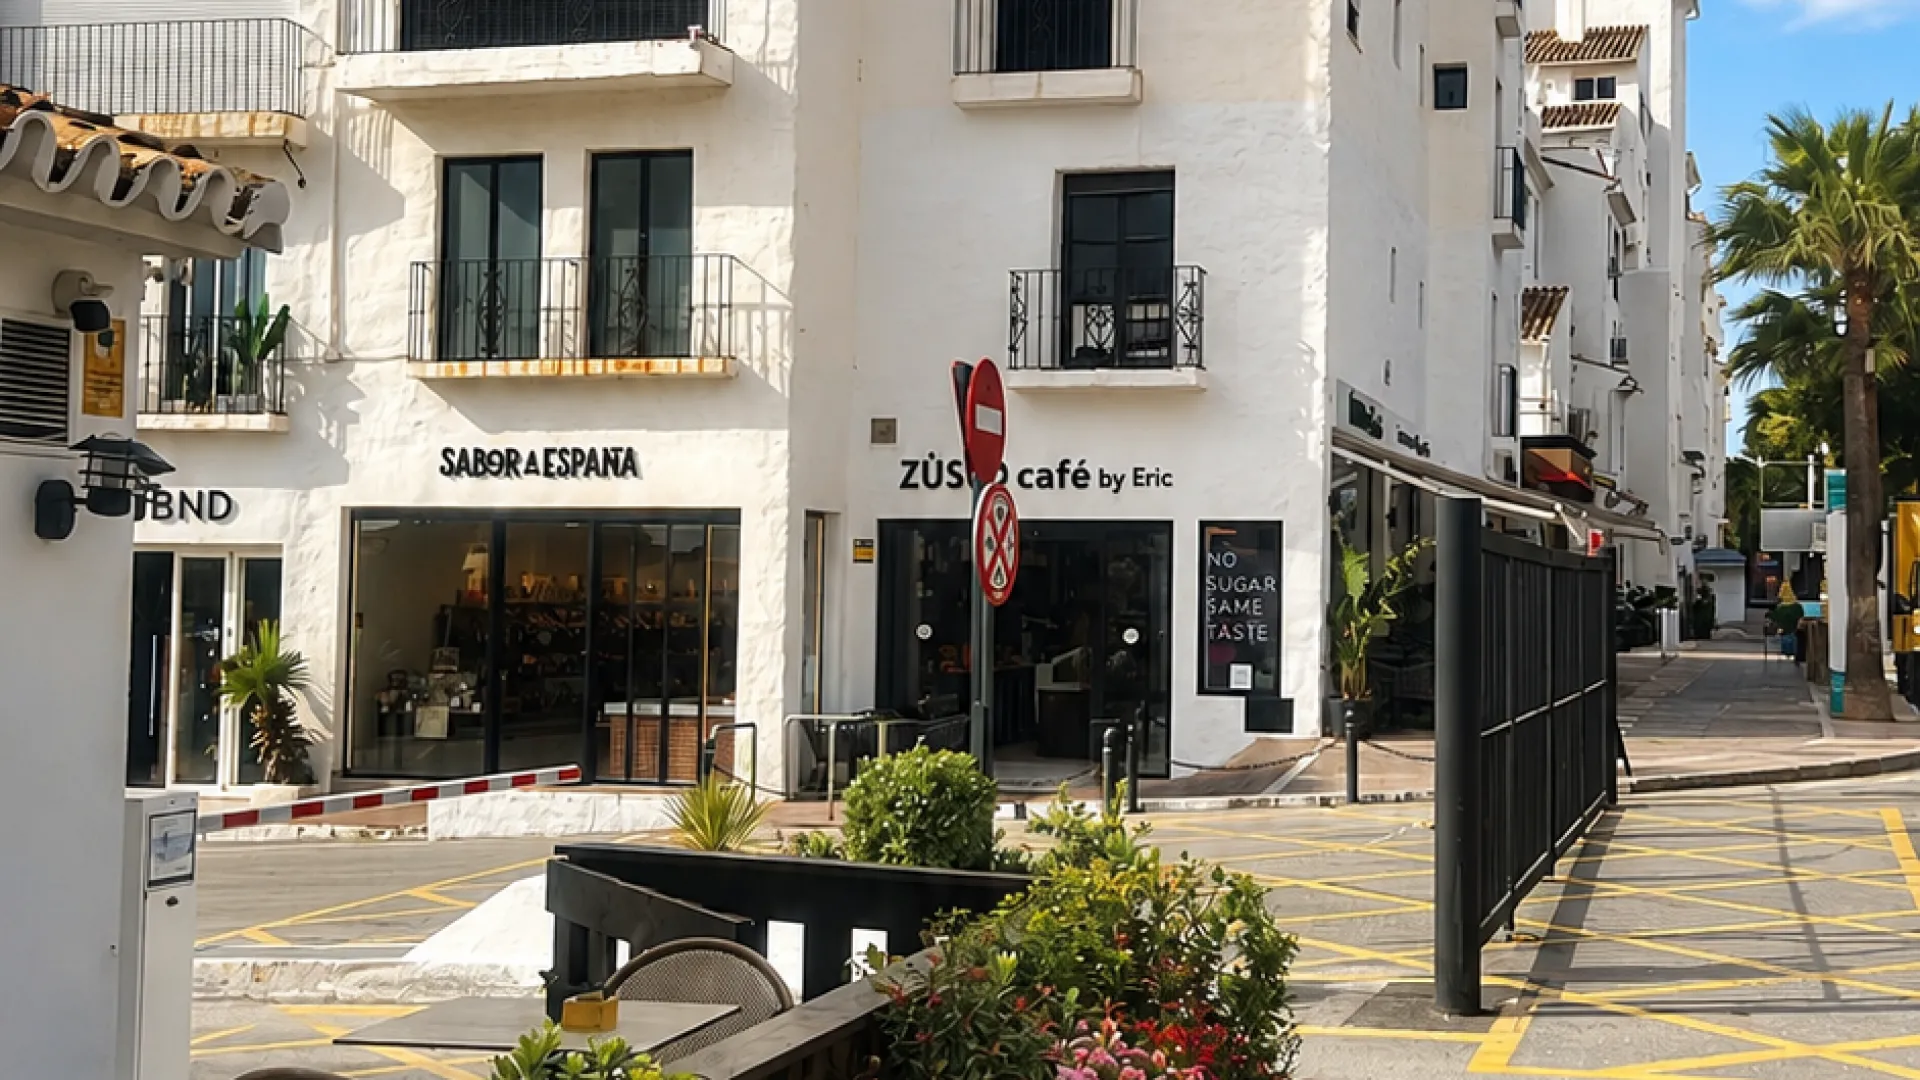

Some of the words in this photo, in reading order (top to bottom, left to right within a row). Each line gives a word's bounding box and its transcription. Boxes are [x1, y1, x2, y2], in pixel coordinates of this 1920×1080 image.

[439, 447, 522, 477] SABOR
[1017, 459, 1090, 489] café
[1099, 468, 1125, 493] by
[1132, 467, 1173, 487] Eric
[1207, 551, 1237, 568] NO
[1206, 575, 1276, 592] SUGAR
[1206, 598, 1263, 615] SAME
[1207, 624, 1268, 641] TASTE
